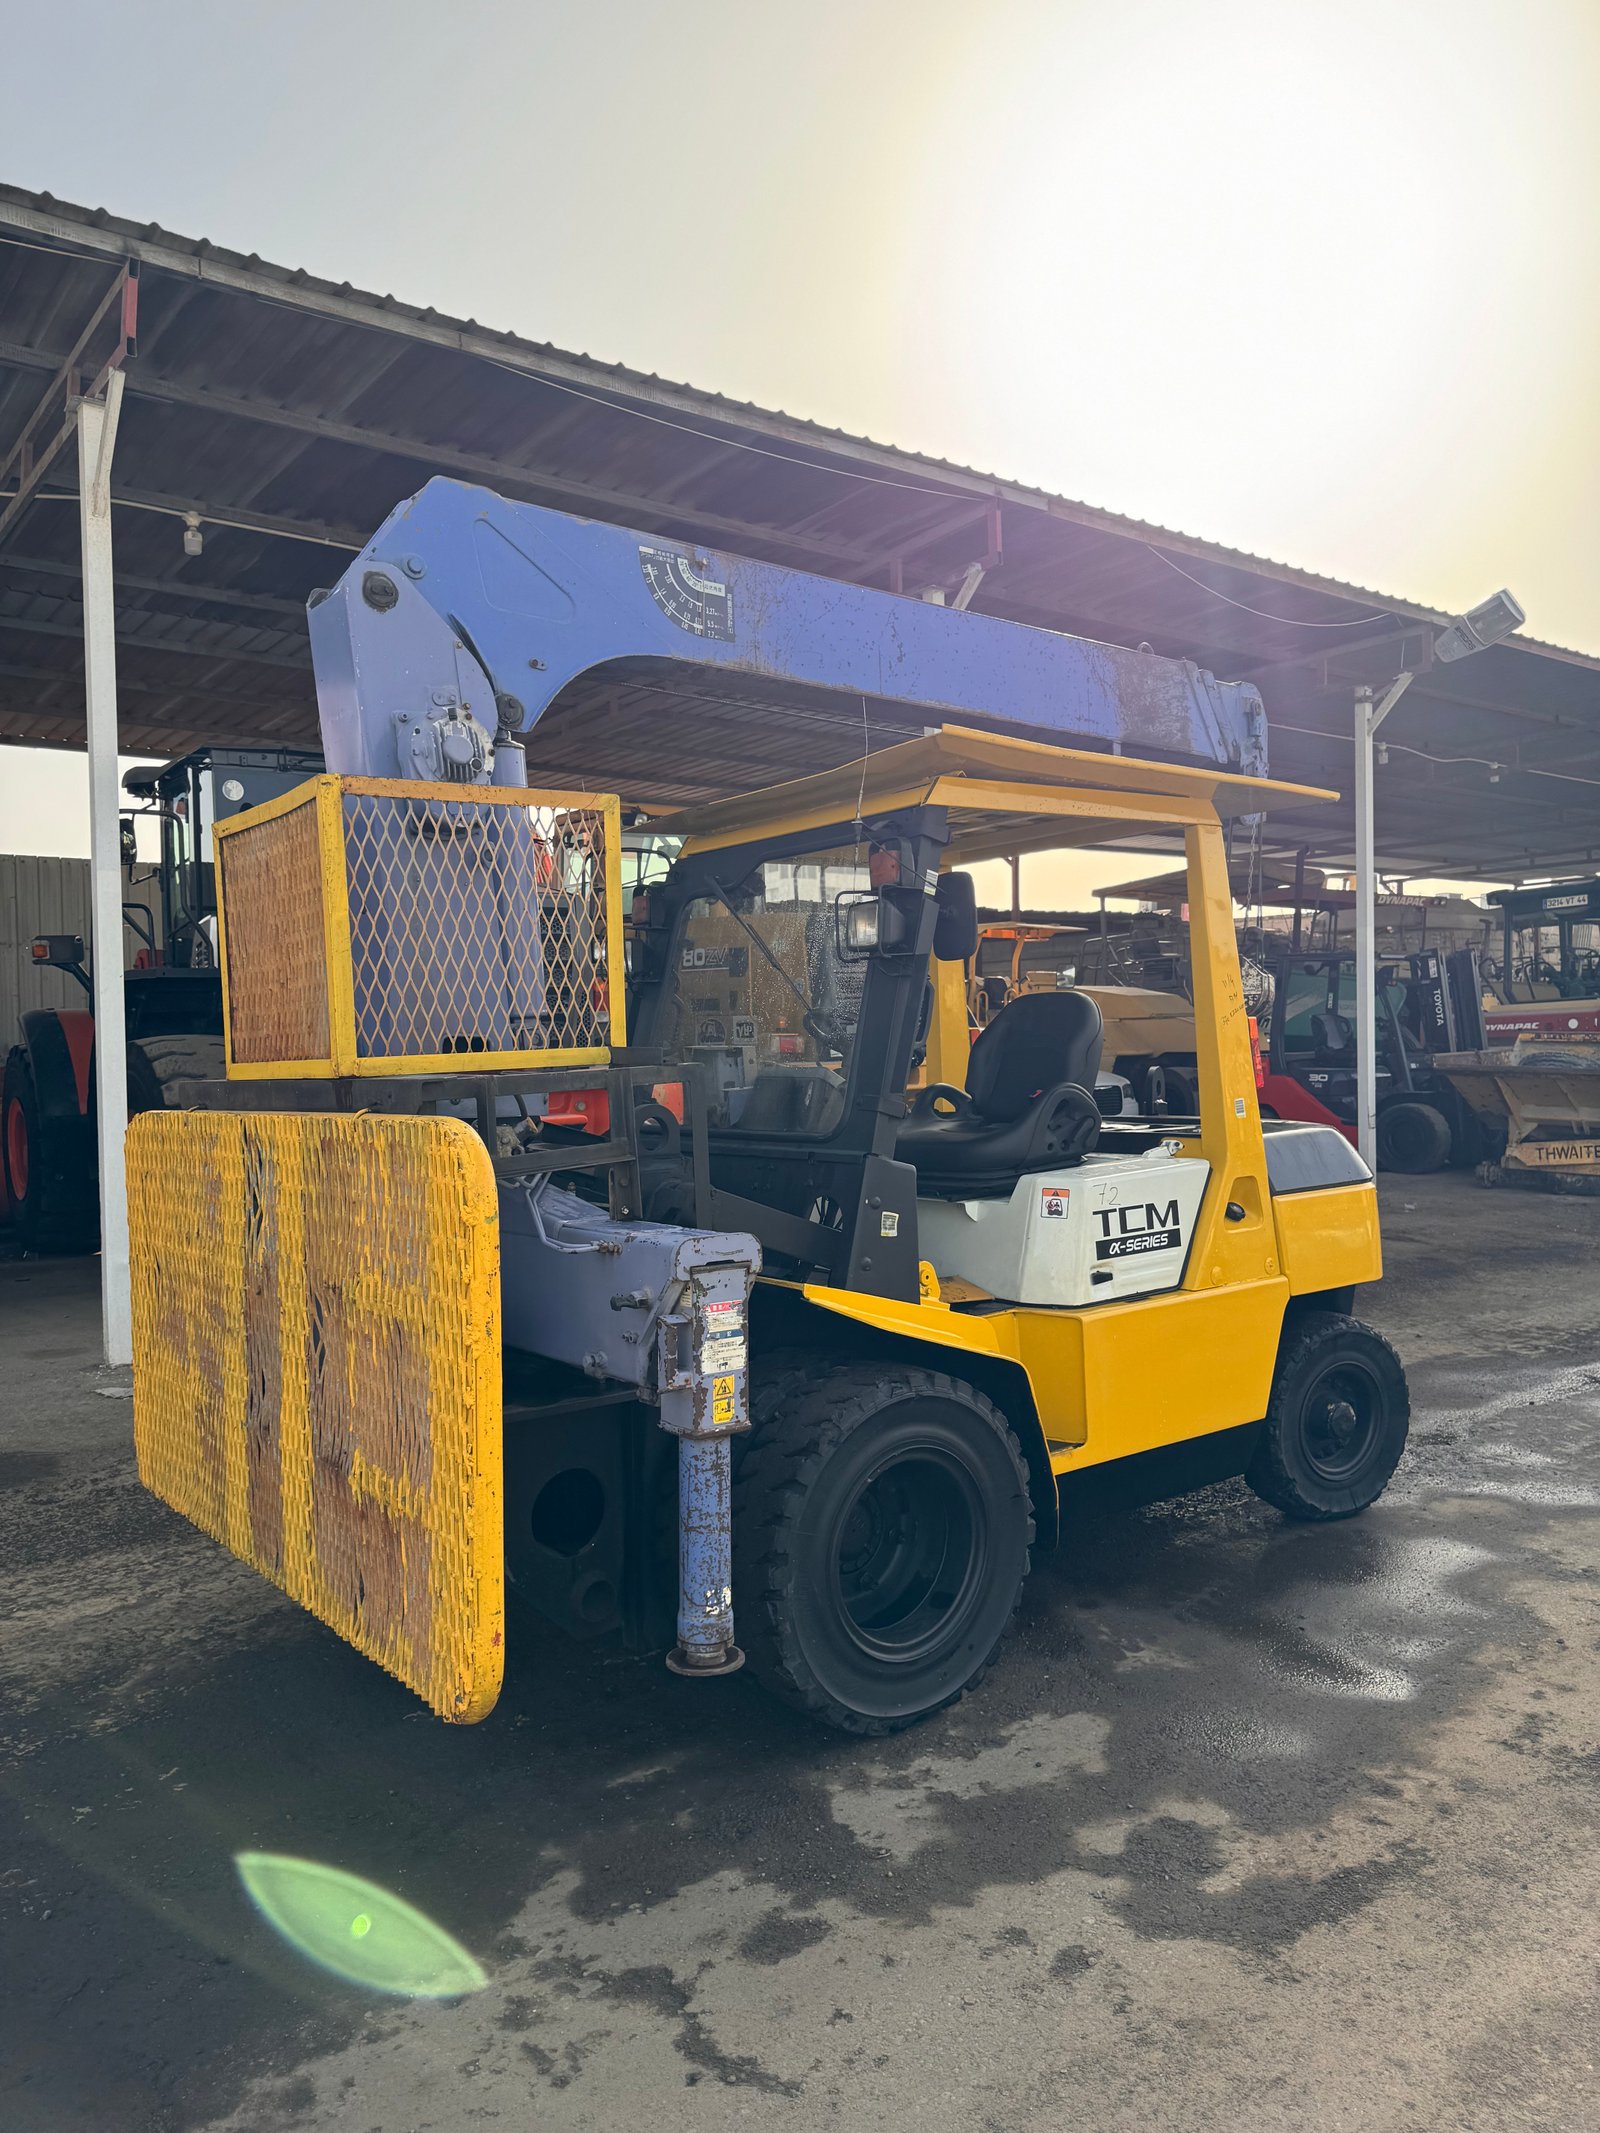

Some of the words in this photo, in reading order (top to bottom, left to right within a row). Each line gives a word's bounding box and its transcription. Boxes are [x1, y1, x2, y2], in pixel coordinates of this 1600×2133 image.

[1377, 895, 1426, 906] DYNAPAC
[1433, 989, 1444, 1026] TOYOTA
[1092, 1182, 1121, 1206] 72
[1092, 1200, 1180, 1238] TCM
